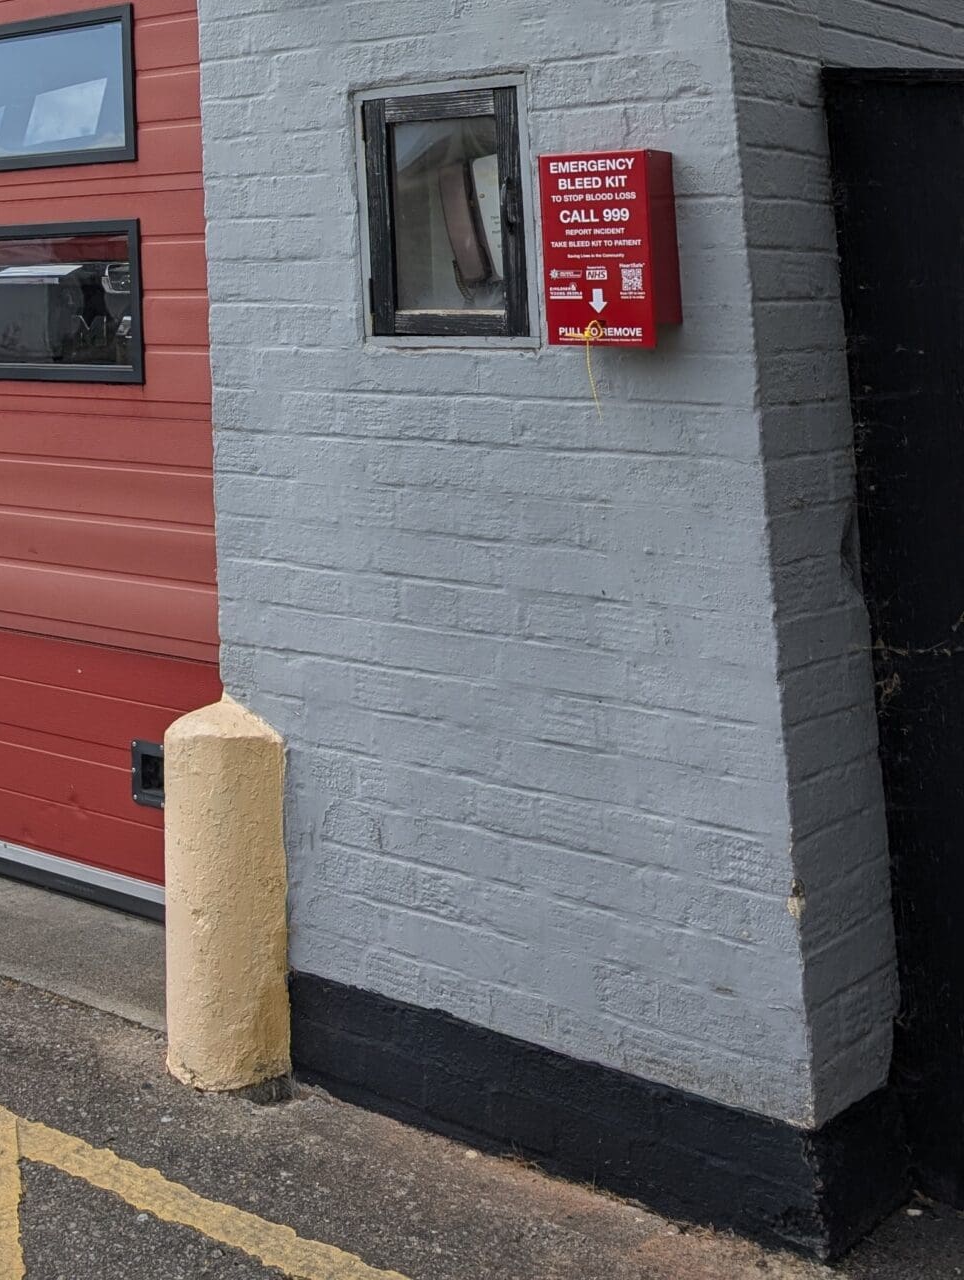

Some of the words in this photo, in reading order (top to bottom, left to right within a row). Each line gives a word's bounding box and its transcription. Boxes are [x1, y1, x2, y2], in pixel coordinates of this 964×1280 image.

[549, 157, 635, 174] EMERGENCY
[558, 176, 602, 190] BLEED
[605, 175, 627, 188] KIT
[551, 195, 562, 203] TO
[563, 194, 584, 202] STOP
[585, 193, 614, 201] BLOOD
[614, 191, 636, 200] LOSS
[559, 209, 600, 223] CALL
[602, 207, 630, 222] 999
[565, 228, 592, 236] REPORT
[593, 227, 625, 235] INCIDENT
[568, 240, 590, 248] BLEED
[587, 271, 606, 279] NHS
[558, 327, 581, 336] PULL
[601, 327, 643, 337] REMOVE
